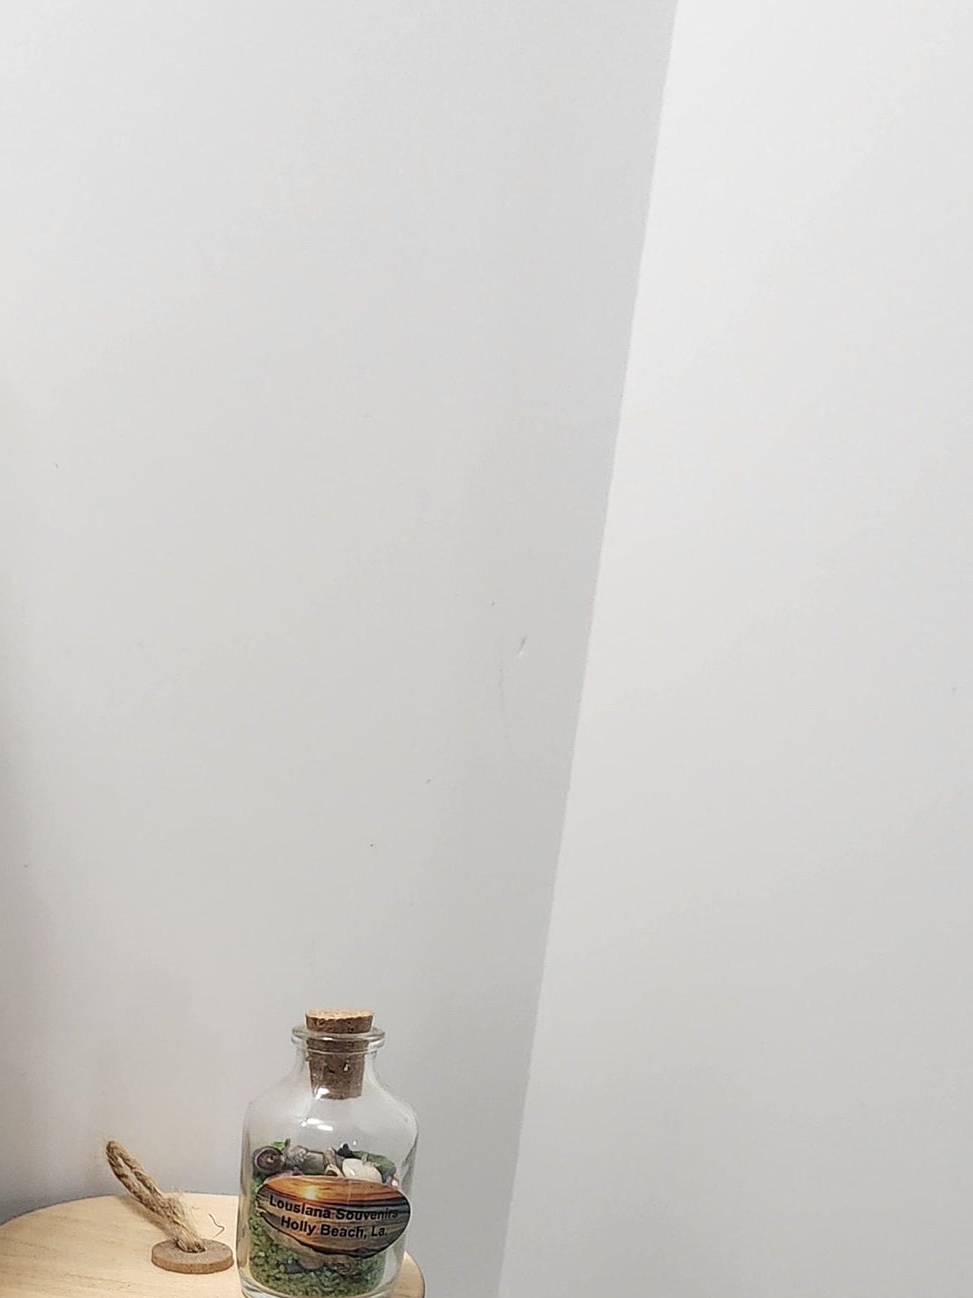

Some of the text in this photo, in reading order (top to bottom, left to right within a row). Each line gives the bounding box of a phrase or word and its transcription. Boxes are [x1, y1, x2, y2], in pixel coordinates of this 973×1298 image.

[280, 1215, 388, 1239] Holly Beach, La.
